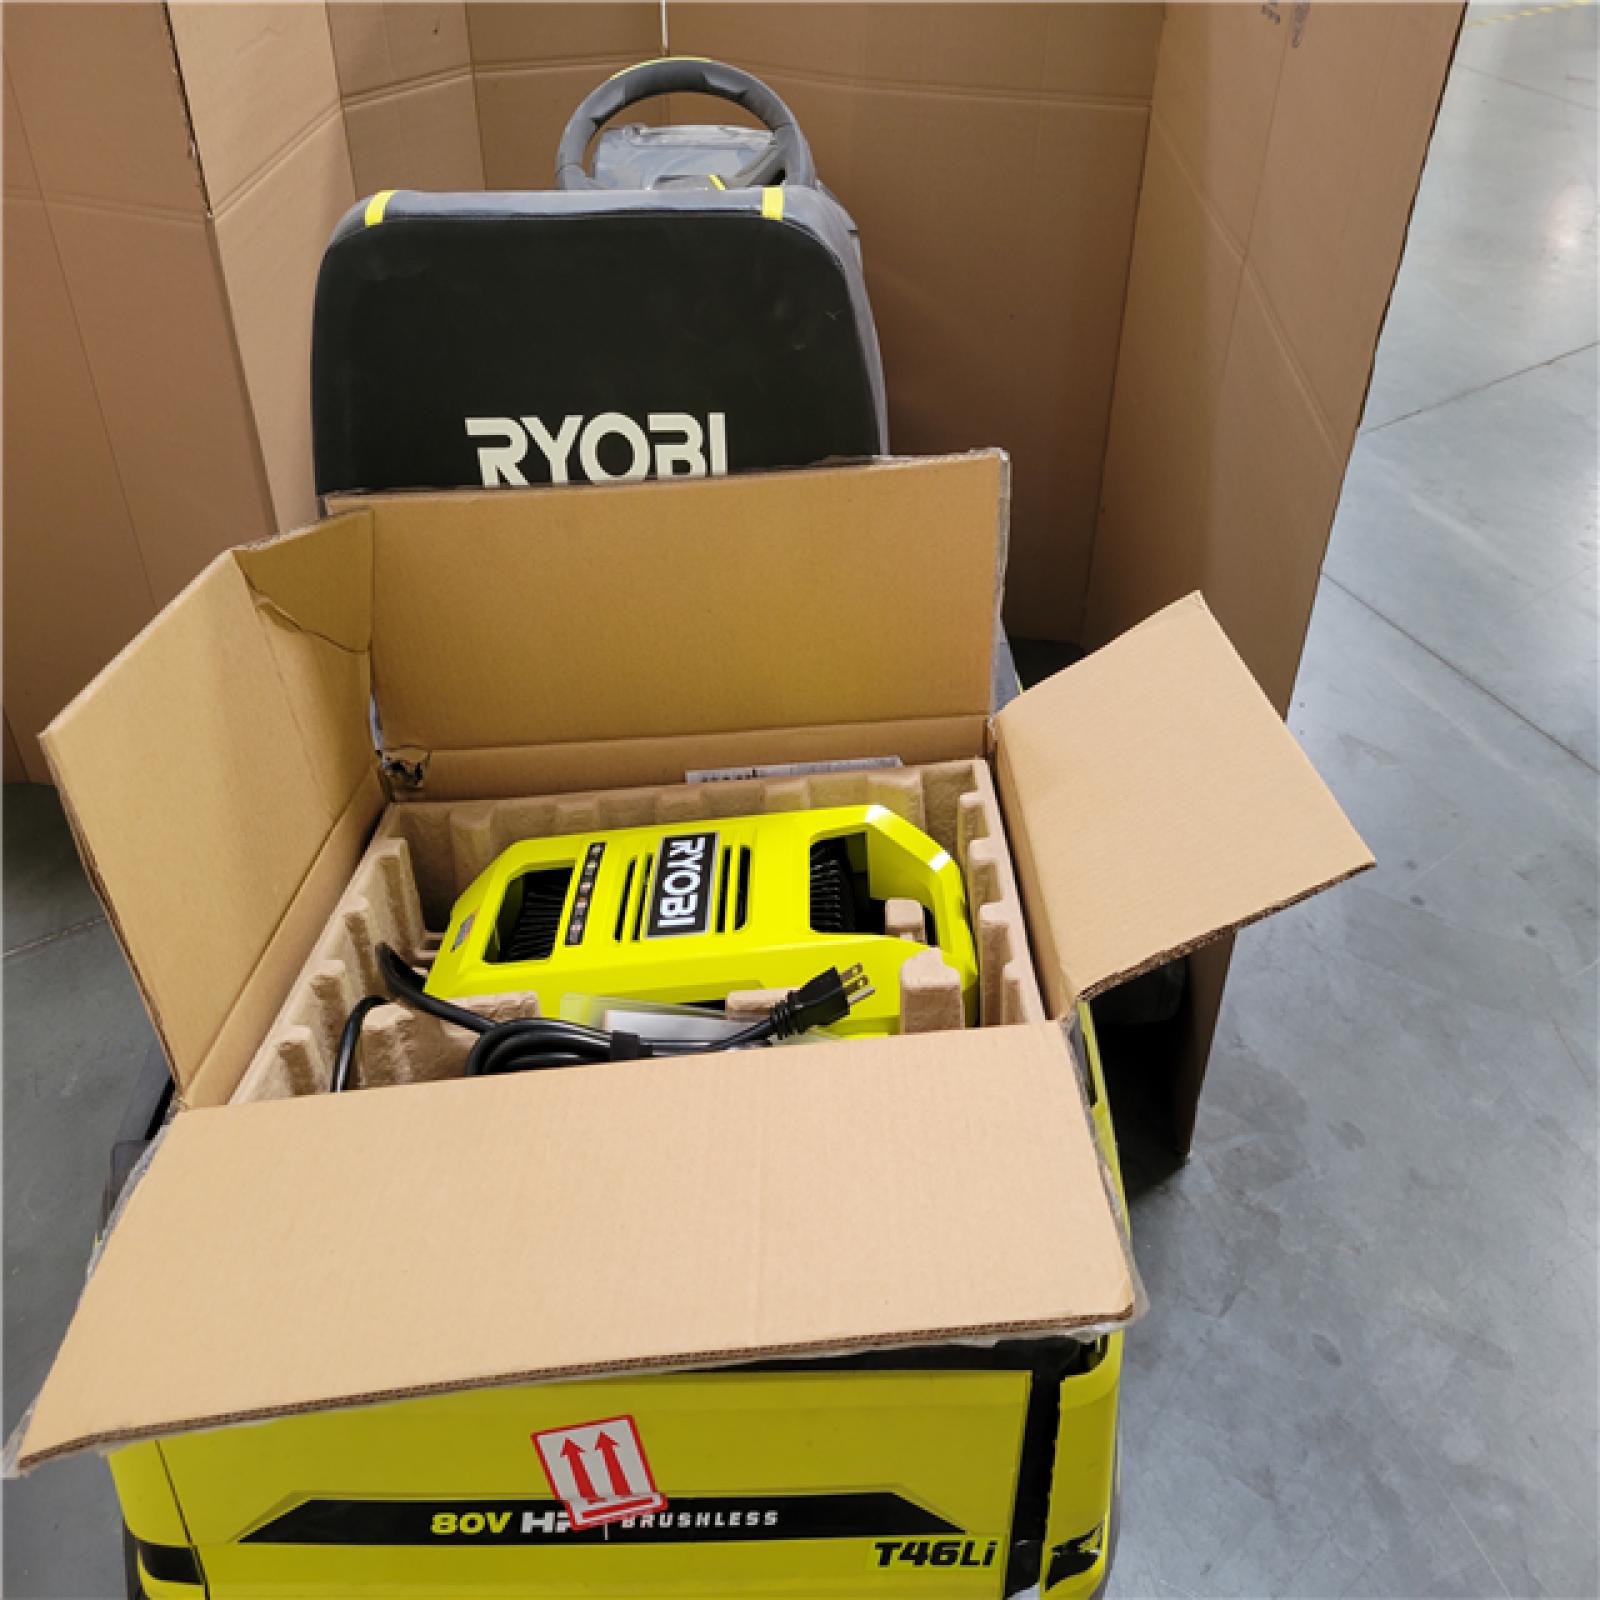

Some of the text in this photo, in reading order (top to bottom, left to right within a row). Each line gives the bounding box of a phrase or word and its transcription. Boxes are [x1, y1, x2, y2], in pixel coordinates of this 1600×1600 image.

[464, 411, 728, 488] RYOBI
[657, 836, 706, 928] RYOBI
[430, 1511, 514, 1535] 80V
[874, 1539, 999, 1568] T46Li
